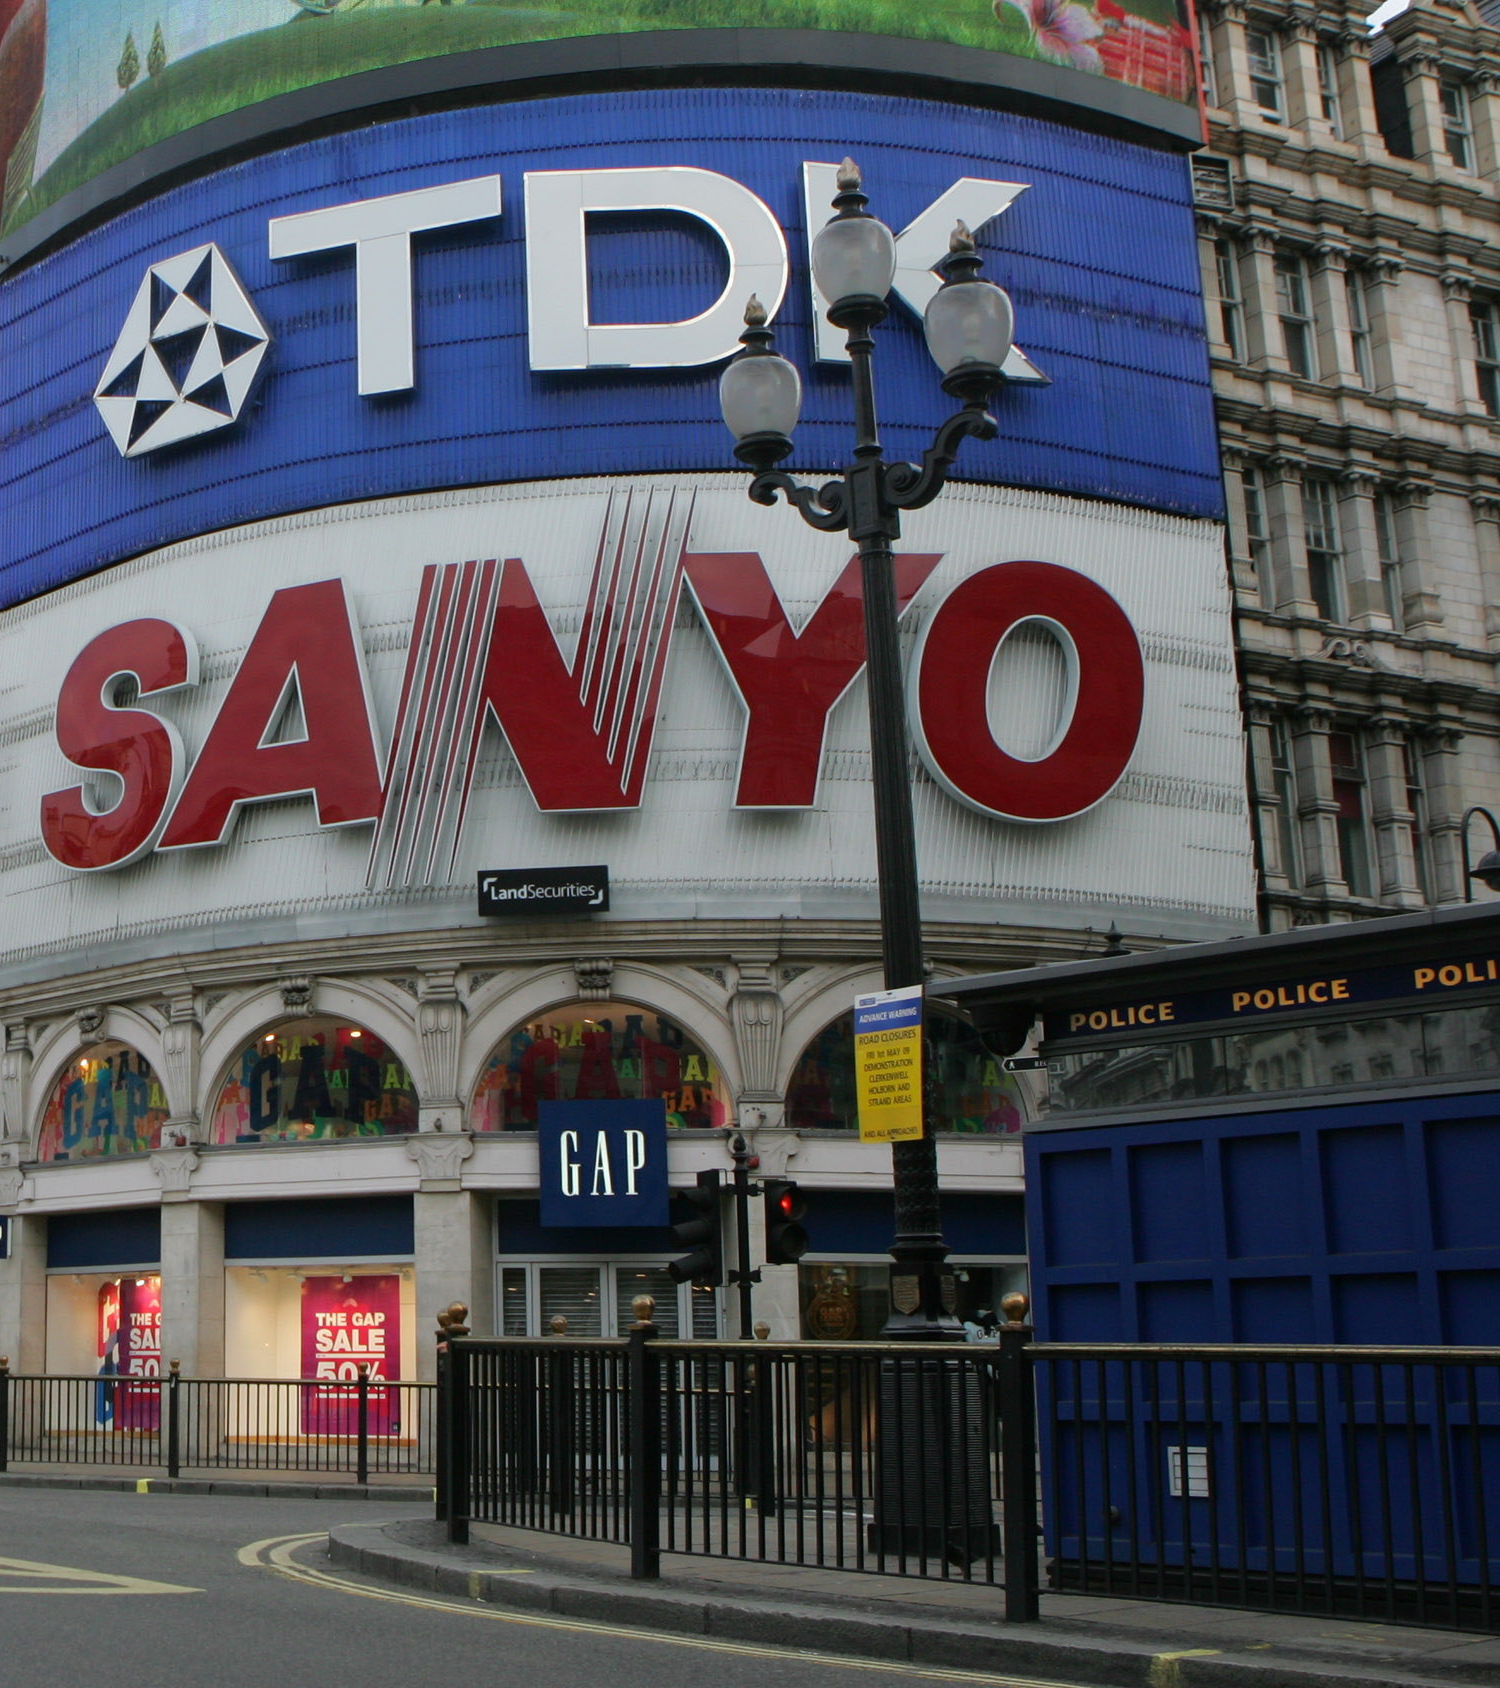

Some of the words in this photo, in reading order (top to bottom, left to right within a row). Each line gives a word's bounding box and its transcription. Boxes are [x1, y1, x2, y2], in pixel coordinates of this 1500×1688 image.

[269, 161, 1051, 398] TDK
[39, 485, 1146, 890] SANYO
[490, 882, 596, 901] LandSecurities
[1232, 978, 1350, 1012] POLICE
[859, 1010, 888, 1024] ADVANCE
[888, 1007, 917, 1020] WARNING
[1070, 1002, 1175, 1032] POLICE
[859, 1034, 879, 1045] ROAD
[881, 1029, 916, 1043] CLOSURES
[887, 1048, 901, 1057] MAY
[864, 1058, 913, 1072] DEMONSTRATION
[869, 1074, 908, 1083] CLERKENWELL
[869, 1084, 895, 1095] HOLBORN
[898, 1083, 910, 1092] AND
[868, 1097, 891, 1107] STRAND
[894, 1095, 912, 1104] AREAS
[864, 1129, 875, 1138] AND
[877, 1128, 886, 1137] ALL
[560, 1130, 647, 1198] GAP
[130, 1313, 152, 1326] THE
[316, 1312, 347, 1326] THE
[352, 1312, 385, 1326] GAP
[316, 1328, 385, 1352] SALE
